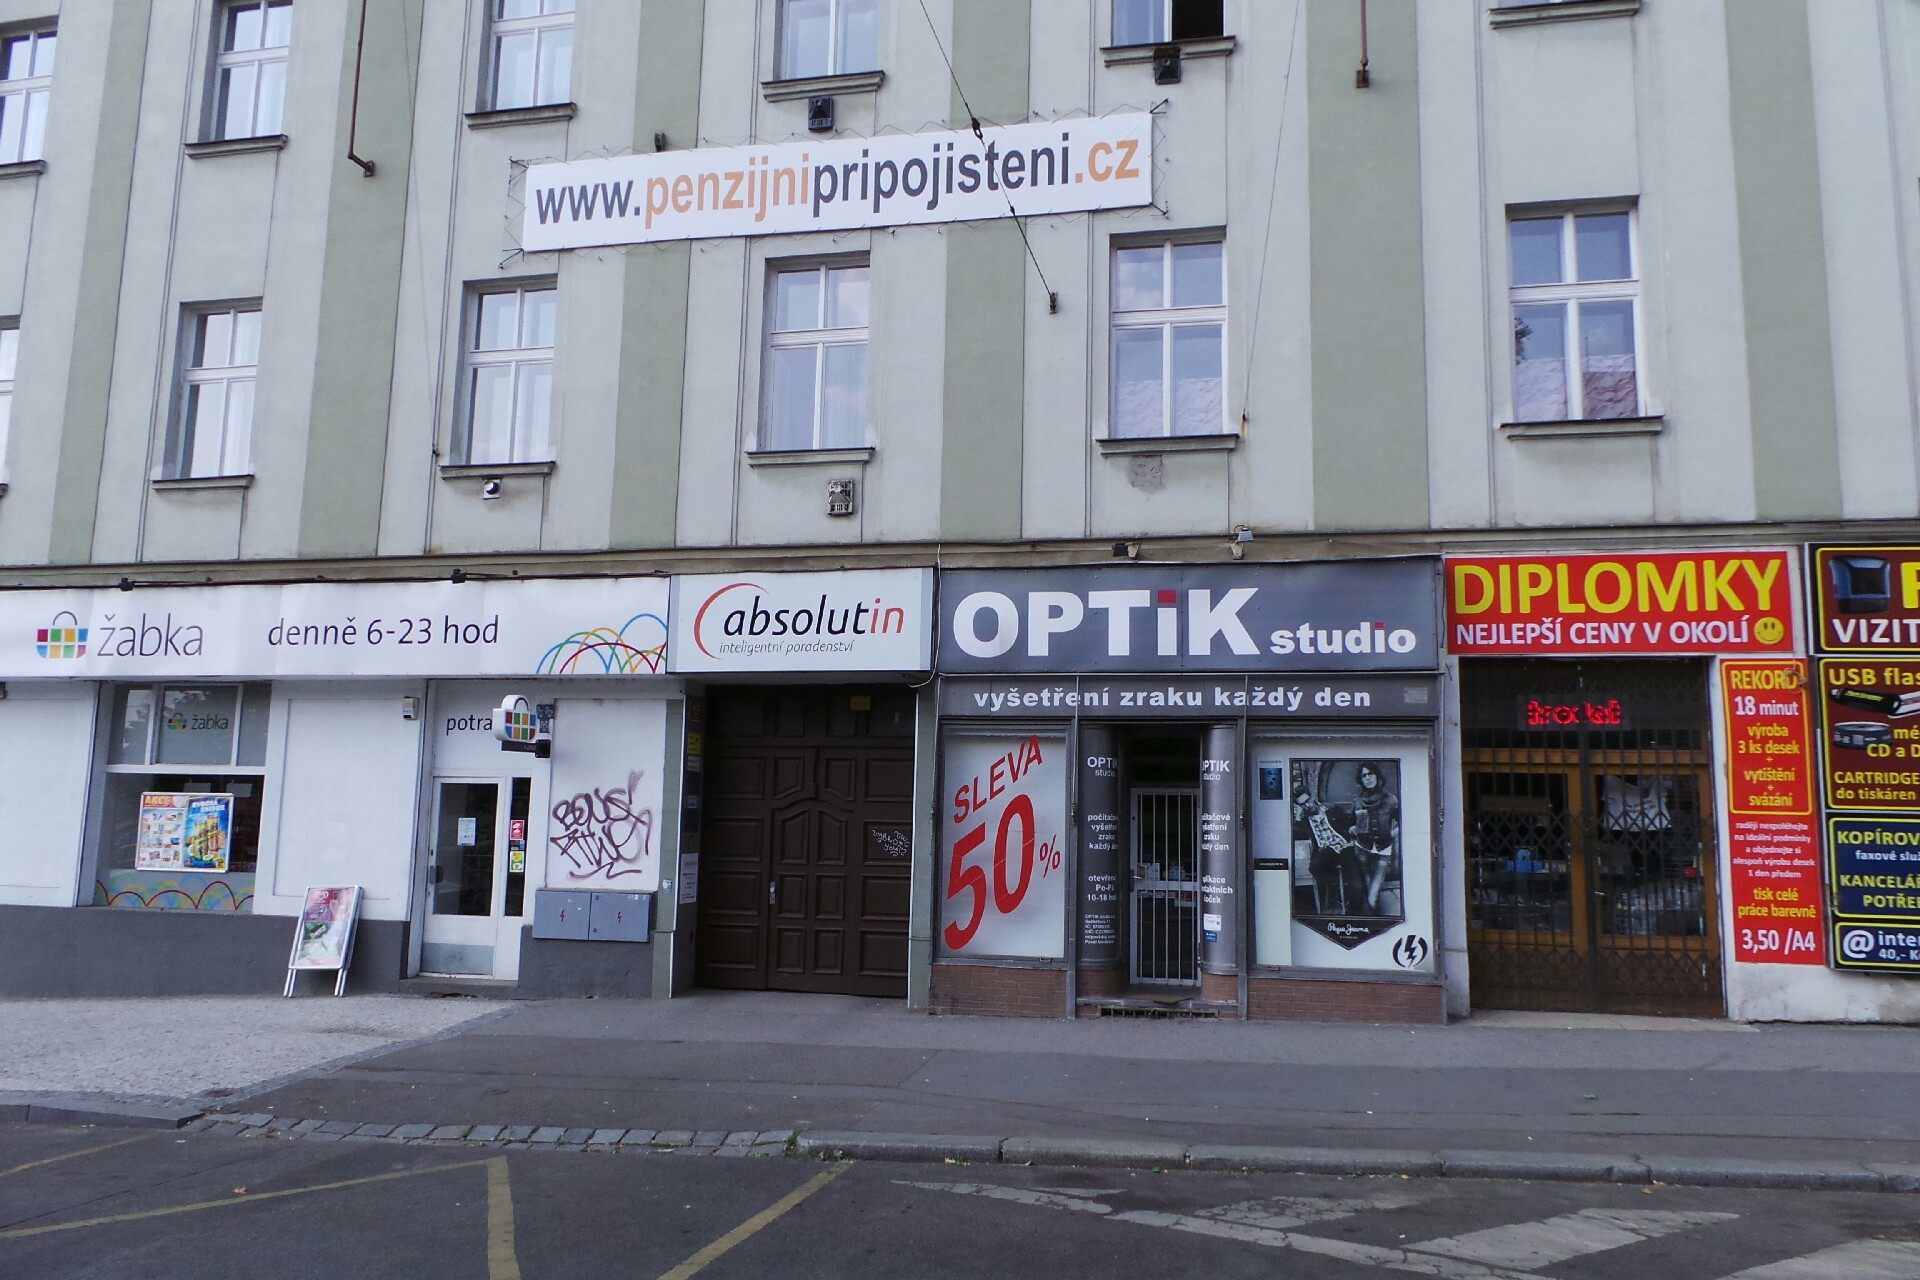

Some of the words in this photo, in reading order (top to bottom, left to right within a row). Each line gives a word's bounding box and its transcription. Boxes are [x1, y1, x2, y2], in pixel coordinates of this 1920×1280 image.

[535, 133, 1140, 230] www.penzijnipripojisteni.cz
[1454, 559, 1782, 614] DIPLOMKY
[723, 594, 905, 636] absolutin
[97, 613, 203, 656] žabka
[268, 616, 357, 646] denně
[367, 618, 432, 645] 6-23
[443, 614, 499, 644] hod
[1270, 621, 1417, 654] studio
[1456, 617, 1563, 645] NEJLEPŠÍ
[1569, 622, 1636, 644] CENY
[1642, 622, 1662, 644] V
[1669, 615, 1750, 644] OKOLÍ
[719, 640, 784, 656] inteligentní
[786, 639, 856, 656] poradenství
[1730, 670, 1798, 690] REKORD
[1828, 668, 1877, 686] USB
[974, 687, 1109, 712] vyšetření
[1120, 687, 1202, 706] zraku
[1214, 686, 1303, 711] každý
[1314, 687, 1371, 707] den
[1734, 695, 1756, 716] 18
[1759, 699, 1799, 716] minut
[191, 713, 228, 730] žabka
[1747, 722, 1789, 740] výroba
[1738, 740, 1746, 754] 3
[1749, 740, 1762, 754] ks
[1765, 740, 1800, 754] desek
[1867, 743, 1891, 757] CD
[1895, 746, 1905, 757] a
[953, 735, 1043, 824] SLEVA
[1743, 767, 1796, 784] vytištění
[1834, 771, 1920, 785] CARTRIDGE
[1749, 791, 1793, 807] svázání
[1836, 787, 1854, 799] do
[1858, 788, 1916, 800] tiskáren
[1214, 843, 1229, 851] den
[1855, 850, 1897, 861] faxové
[1753, 887, 1774, 900] tisk
[1776, 888, 1799, 901] celé
[1738, 903, 1769, 918] práce
[1771, 903, 1816, 918] barevně
[1742, 929, 1779, 953] 3,50
[1784, 928, 1816, 955] /A4
